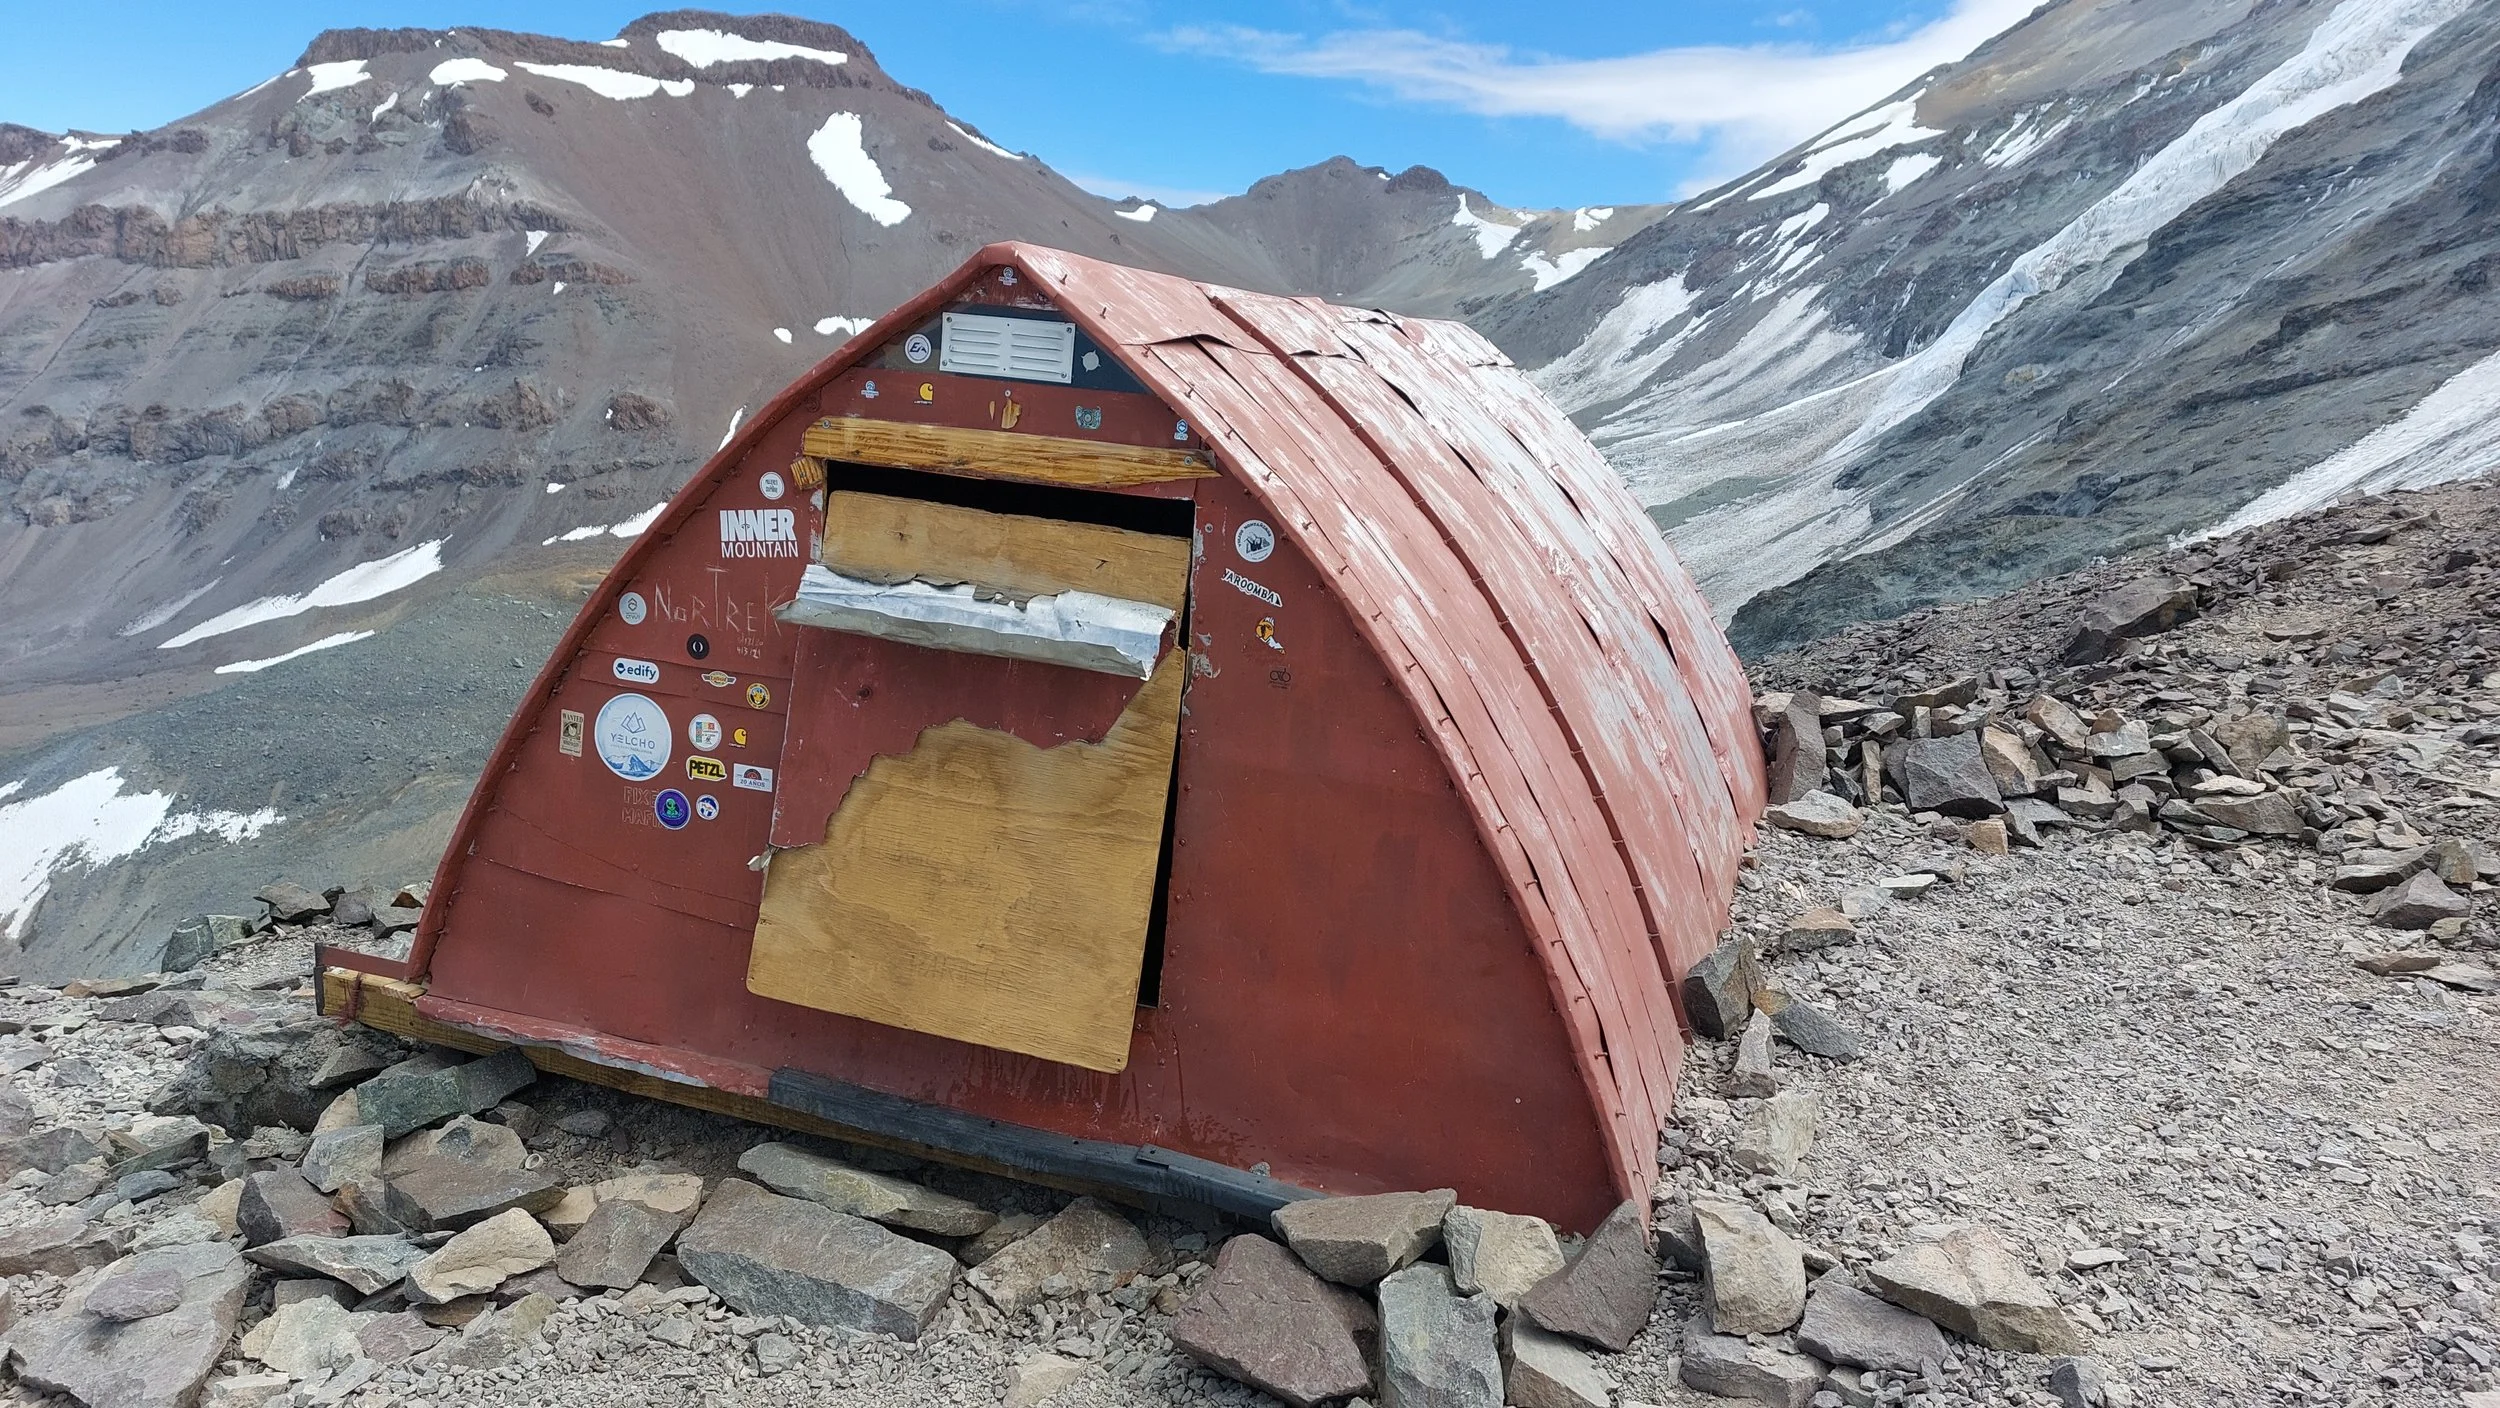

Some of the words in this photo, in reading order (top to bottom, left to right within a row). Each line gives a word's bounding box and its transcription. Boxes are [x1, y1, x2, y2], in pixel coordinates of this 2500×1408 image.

[909, 342, 927, 353] EA
[720, 509, 797, 541] INNER
[721, 541, 799, 558] MOUNTAIN
[627, 664, 656, 680] edify
[610, 732, 656, 750] YELCHO
[689, 760, 726, 779] PETZL
[749, 779, 766, 788] AÑOS
[621, 806, 663, 830] MAFI
